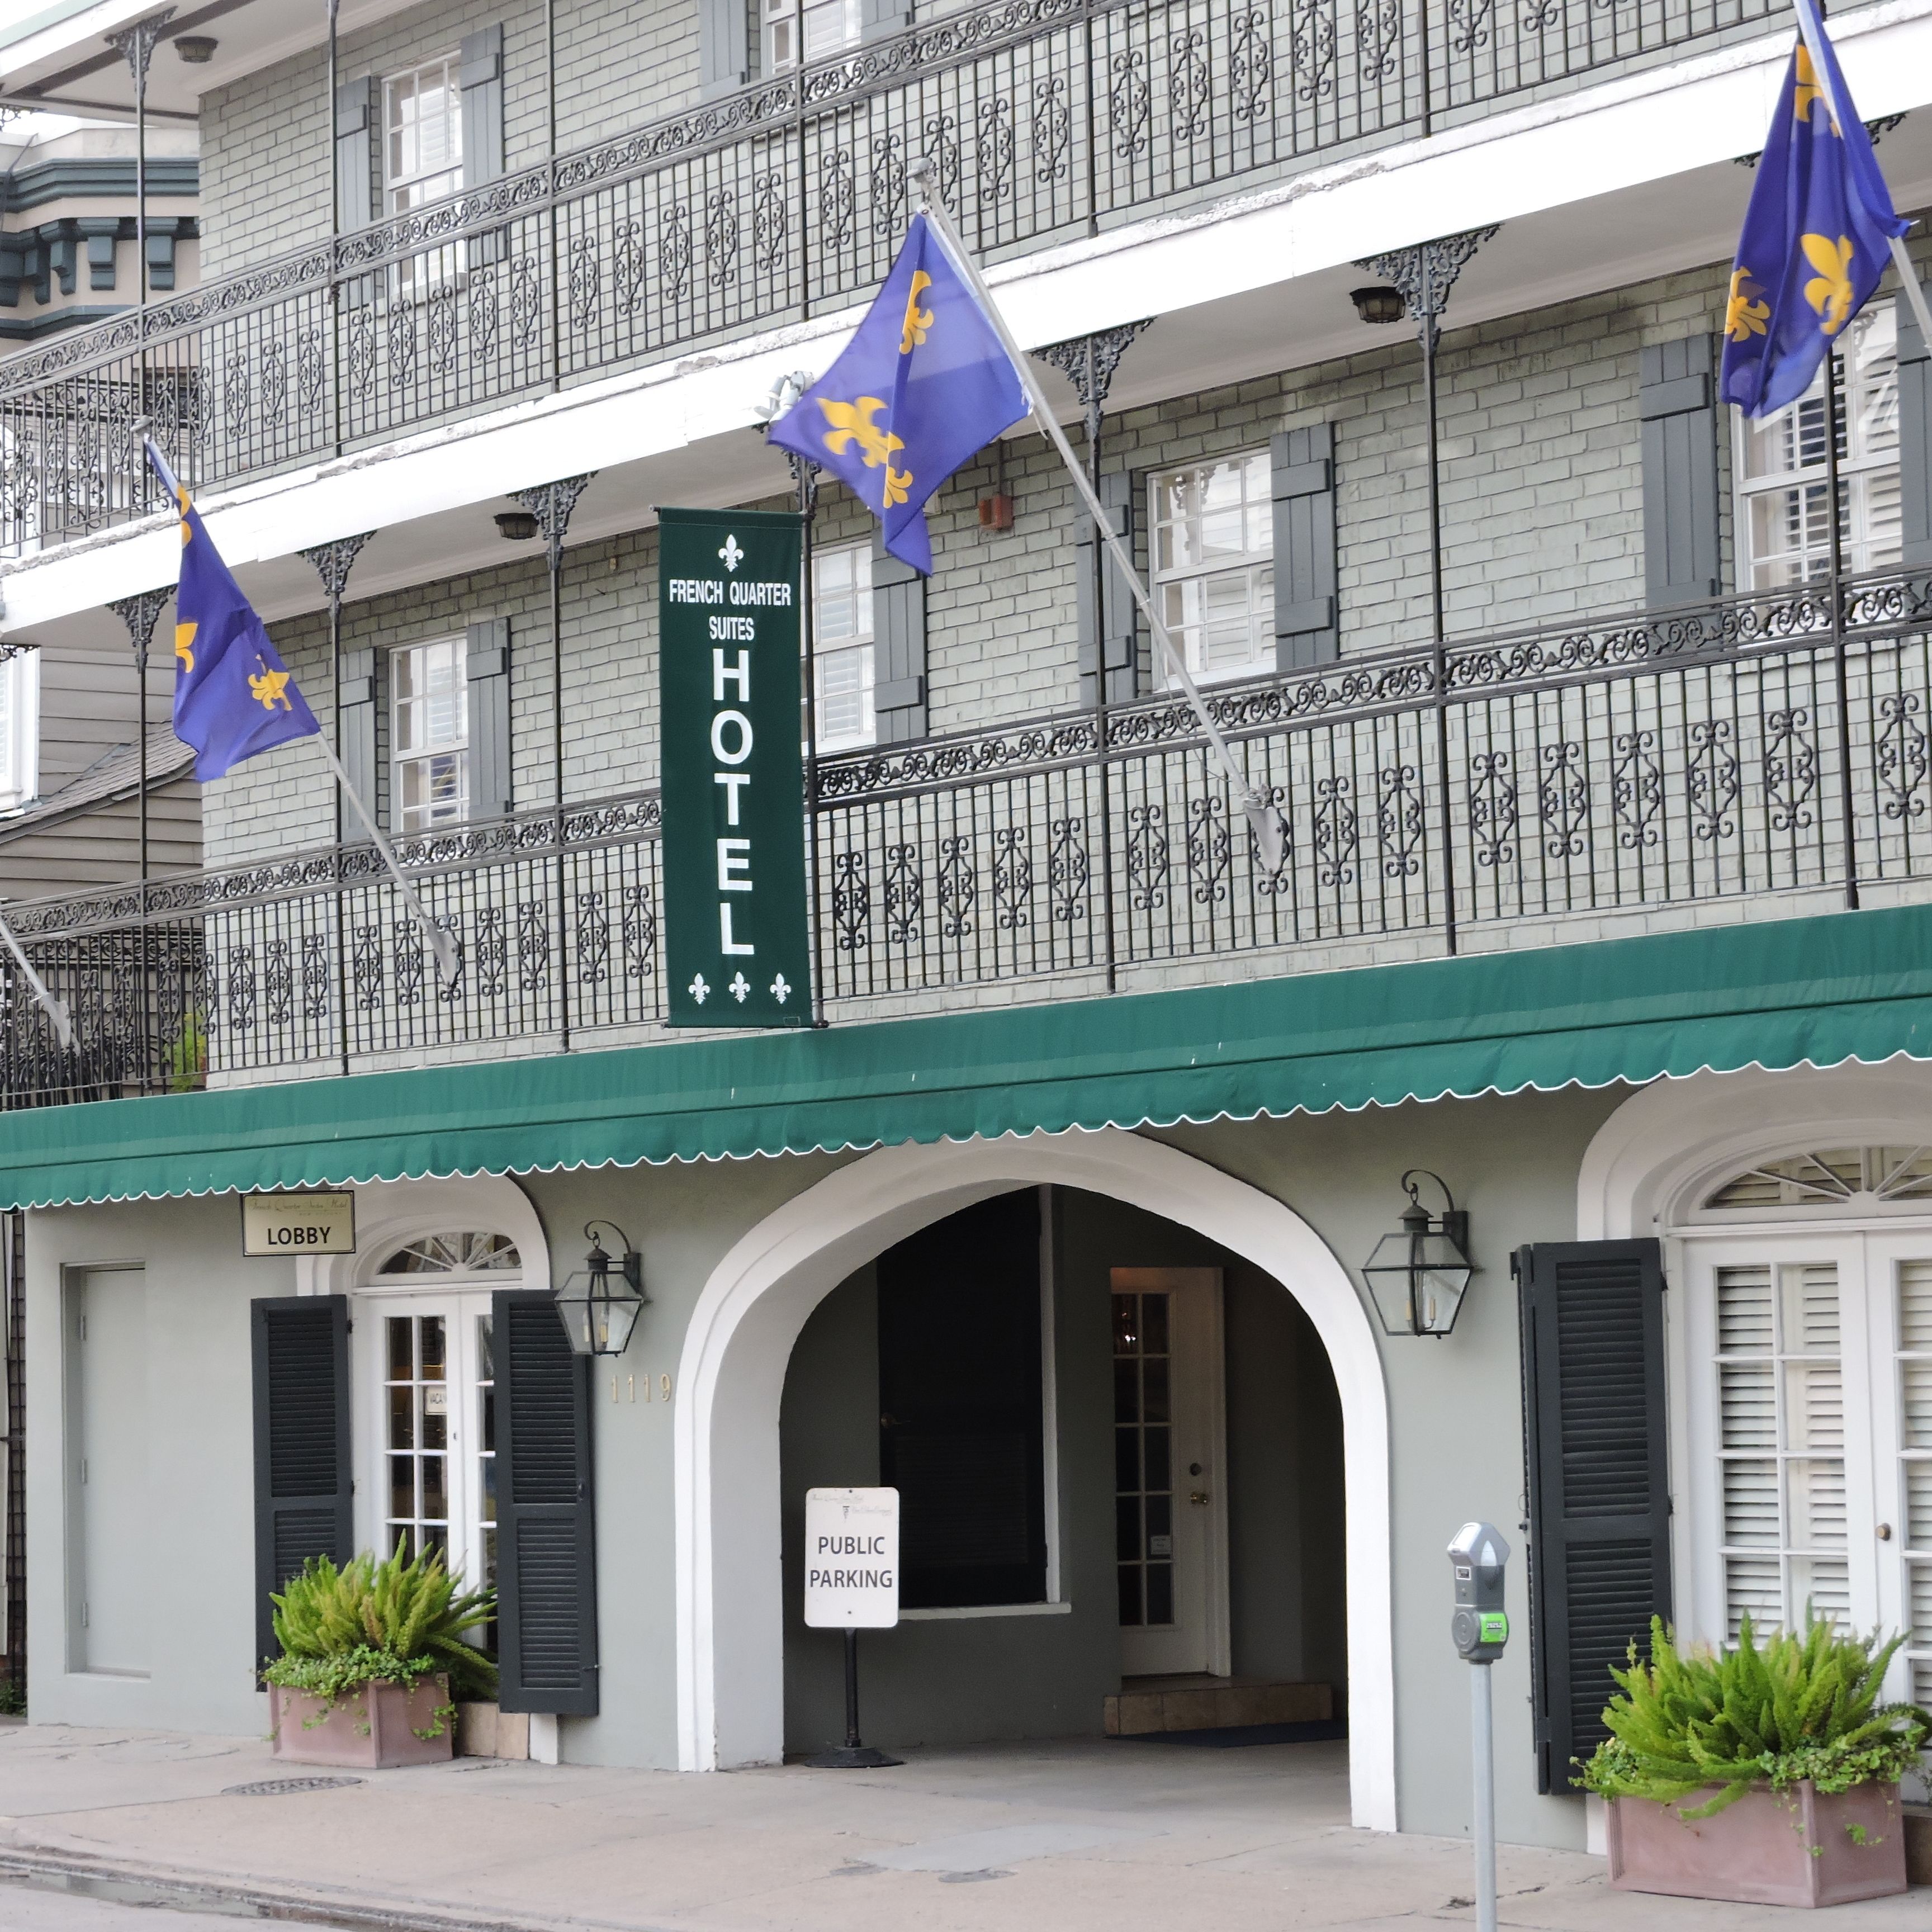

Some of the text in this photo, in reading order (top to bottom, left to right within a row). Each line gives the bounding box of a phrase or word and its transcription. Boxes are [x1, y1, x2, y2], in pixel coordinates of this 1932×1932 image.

[669, 579, 791, 606] FRENCH QUARTER
[709, 615, 755, 641] SUITES
[711, 648, 755, 955] HOTEL
[268, 1227, 331, 1245] LOBBY
[611, 1374, 671, 1403] 1119
[818, 1536, 884, 1555] PUBLIC
[810, 1570, 892, 1588] PARKING
